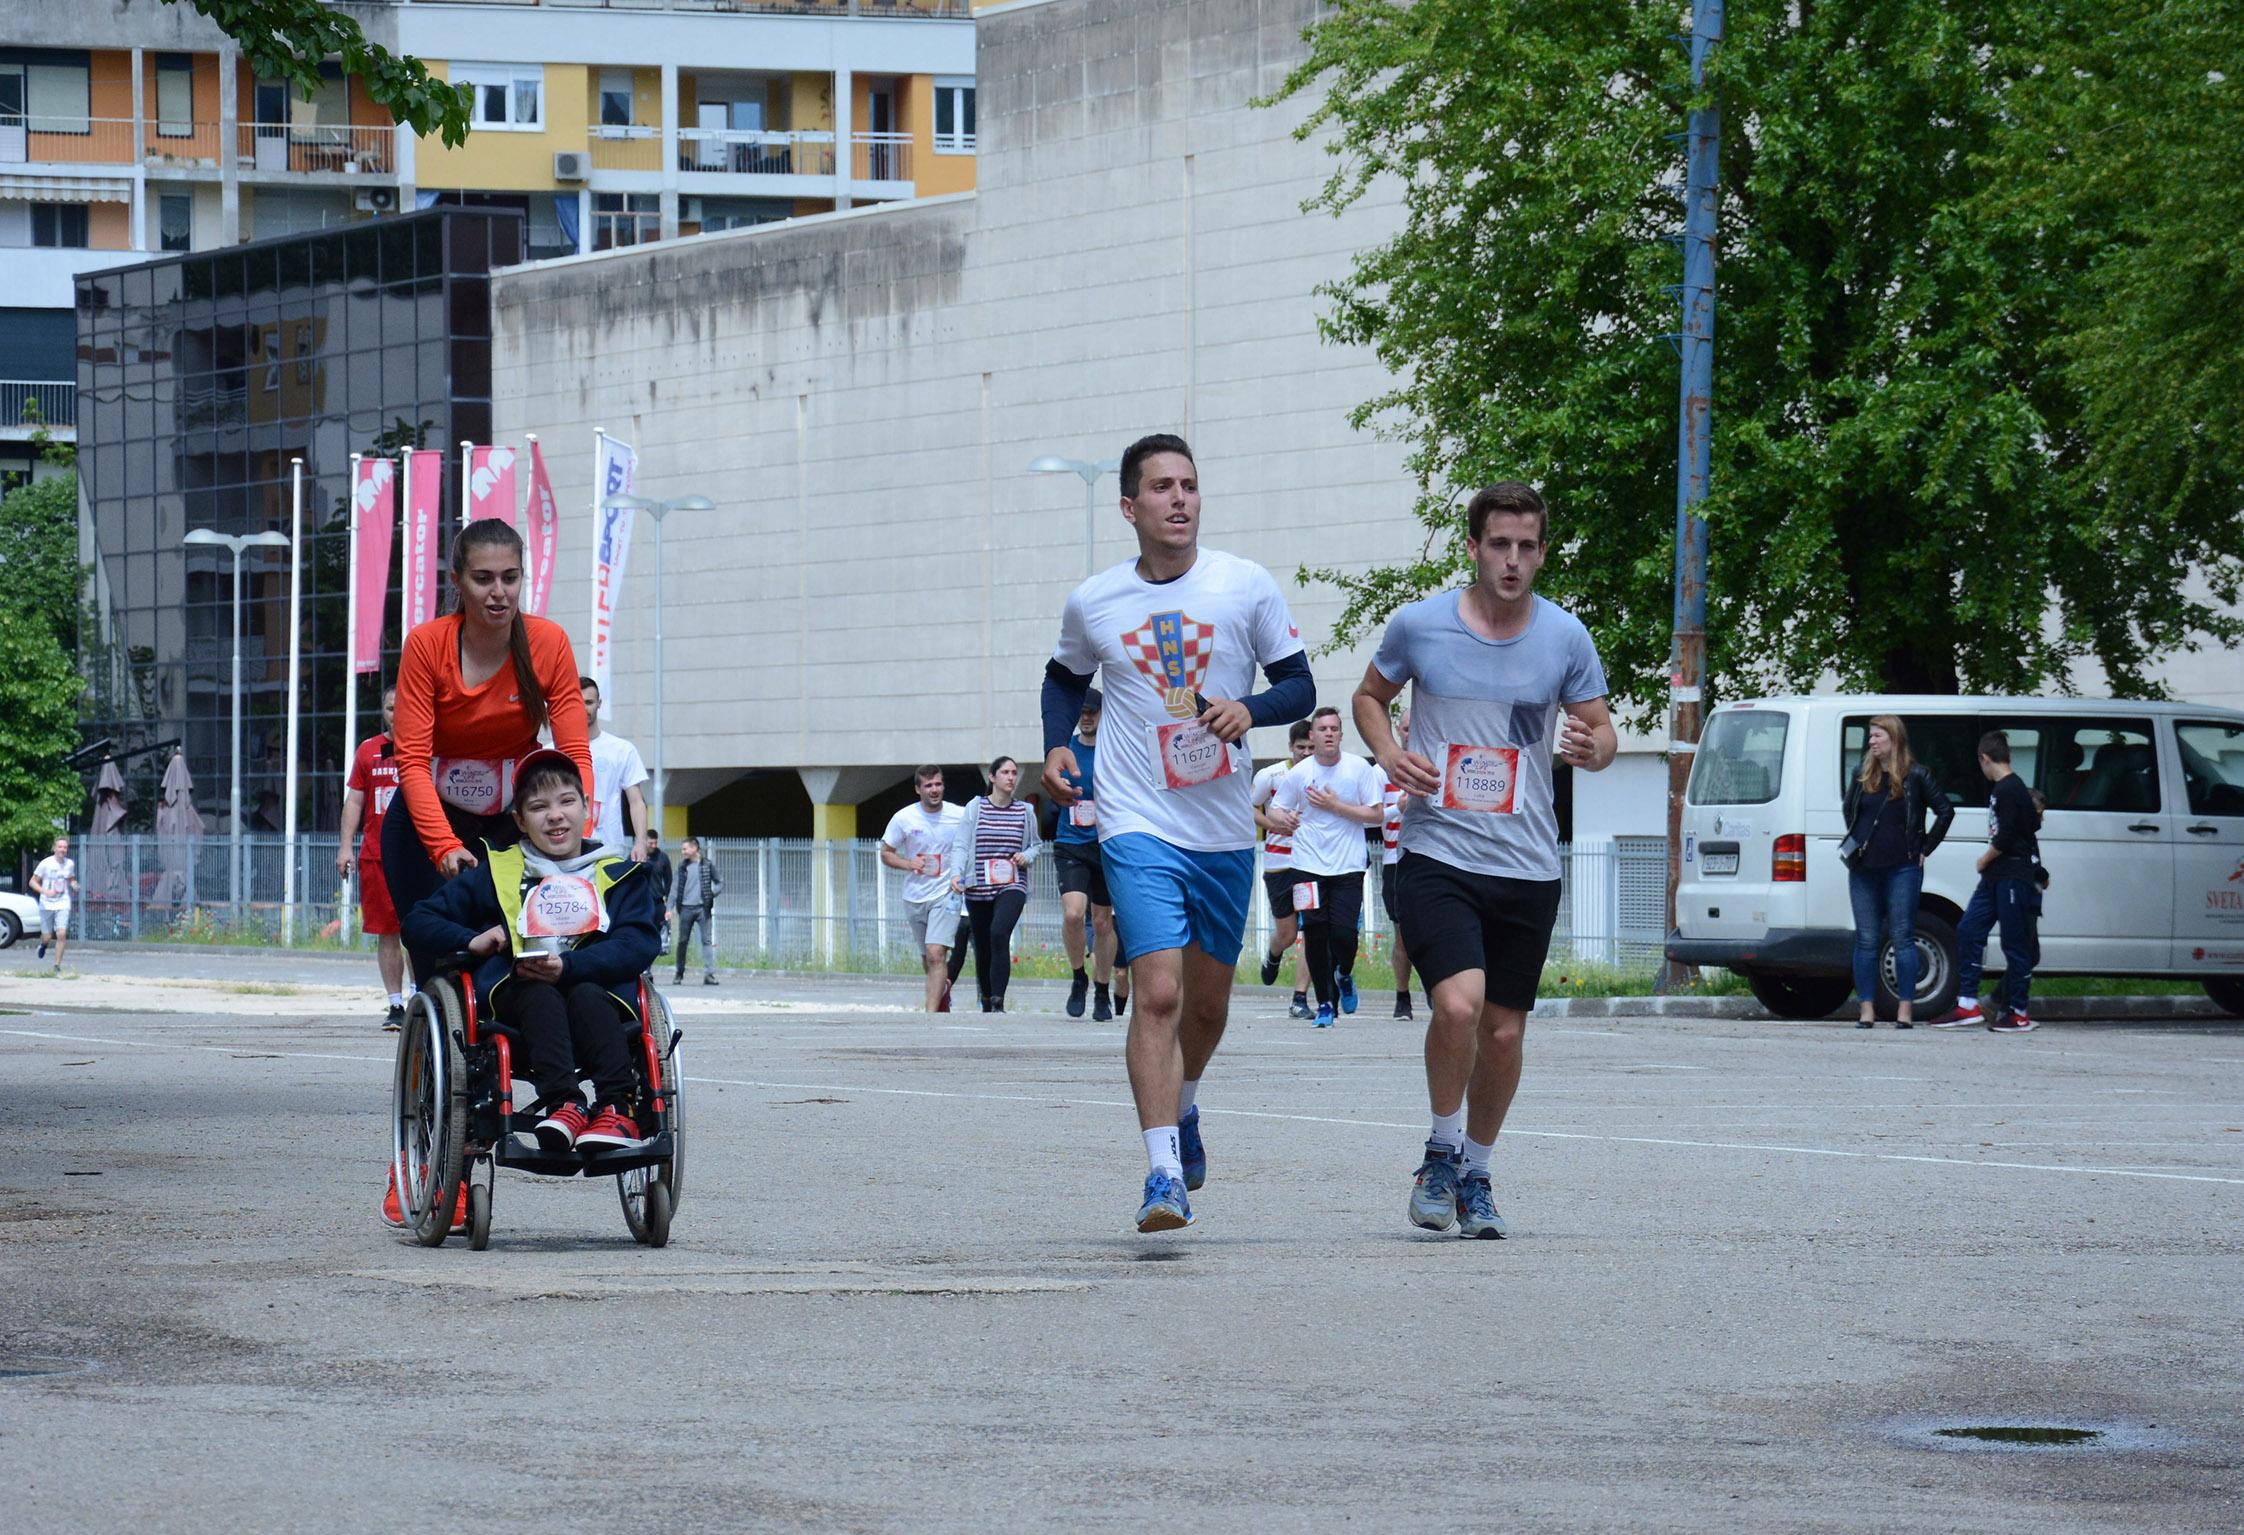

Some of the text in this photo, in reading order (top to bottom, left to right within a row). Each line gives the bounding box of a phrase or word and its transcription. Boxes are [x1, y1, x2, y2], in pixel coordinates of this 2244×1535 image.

[533, 485, 552, 614] ercator
[414, 508, 427, 628] ercator
[1160, 620, 1182, 677] HNS
[1172, 743, 1217, 765] 116727
[445, 785, 493, 797] 116750
[1457, 776, 1506, 792] 118889
[537, 901, 588, 915] 125784
[2207, 891, 2244, 909] SVETA
